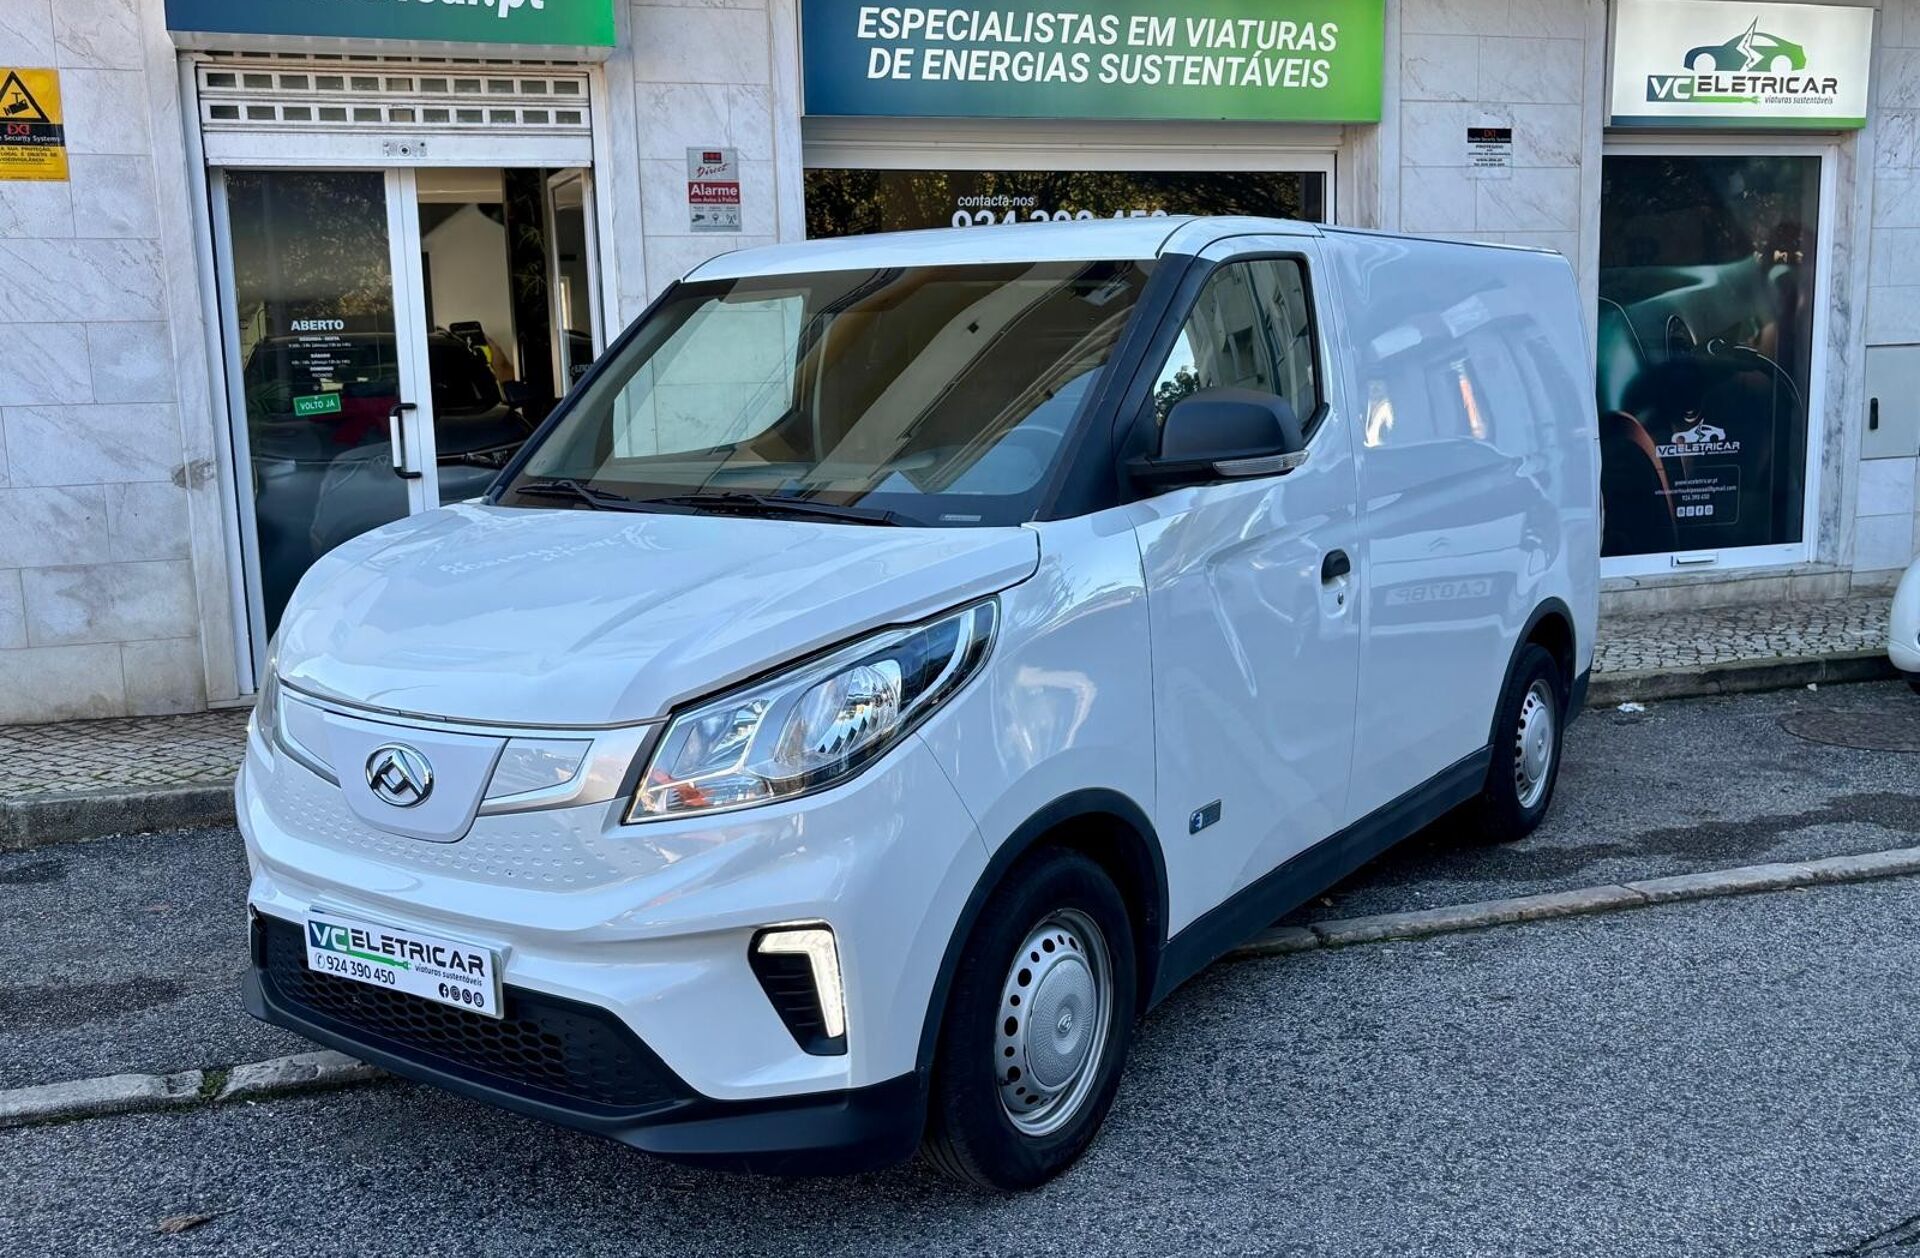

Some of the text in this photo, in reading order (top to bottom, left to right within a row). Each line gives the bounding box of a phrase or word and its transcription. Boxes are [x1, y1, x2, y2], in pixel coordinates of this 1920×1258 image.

[856, 6, 1339, 52] ESPECIALISTAS EM VIATURAS
[867, 47, 1331, 89] DE ENERGIAS SUSTENTÁVEIS
[1764, 95, 1792, 105] viaturas
[697, 163, 729, 178] Direct
[691, 184, 738, 196] Alarme
[957, 195, 1035, 207] contacta-nos
[291, 320, 344, 331] ABERTO
[300, 400, 324, 410] VOLTO
[326, 955, 396, 986] 924 390 450
[414, 963, 442, 977] viaturas
